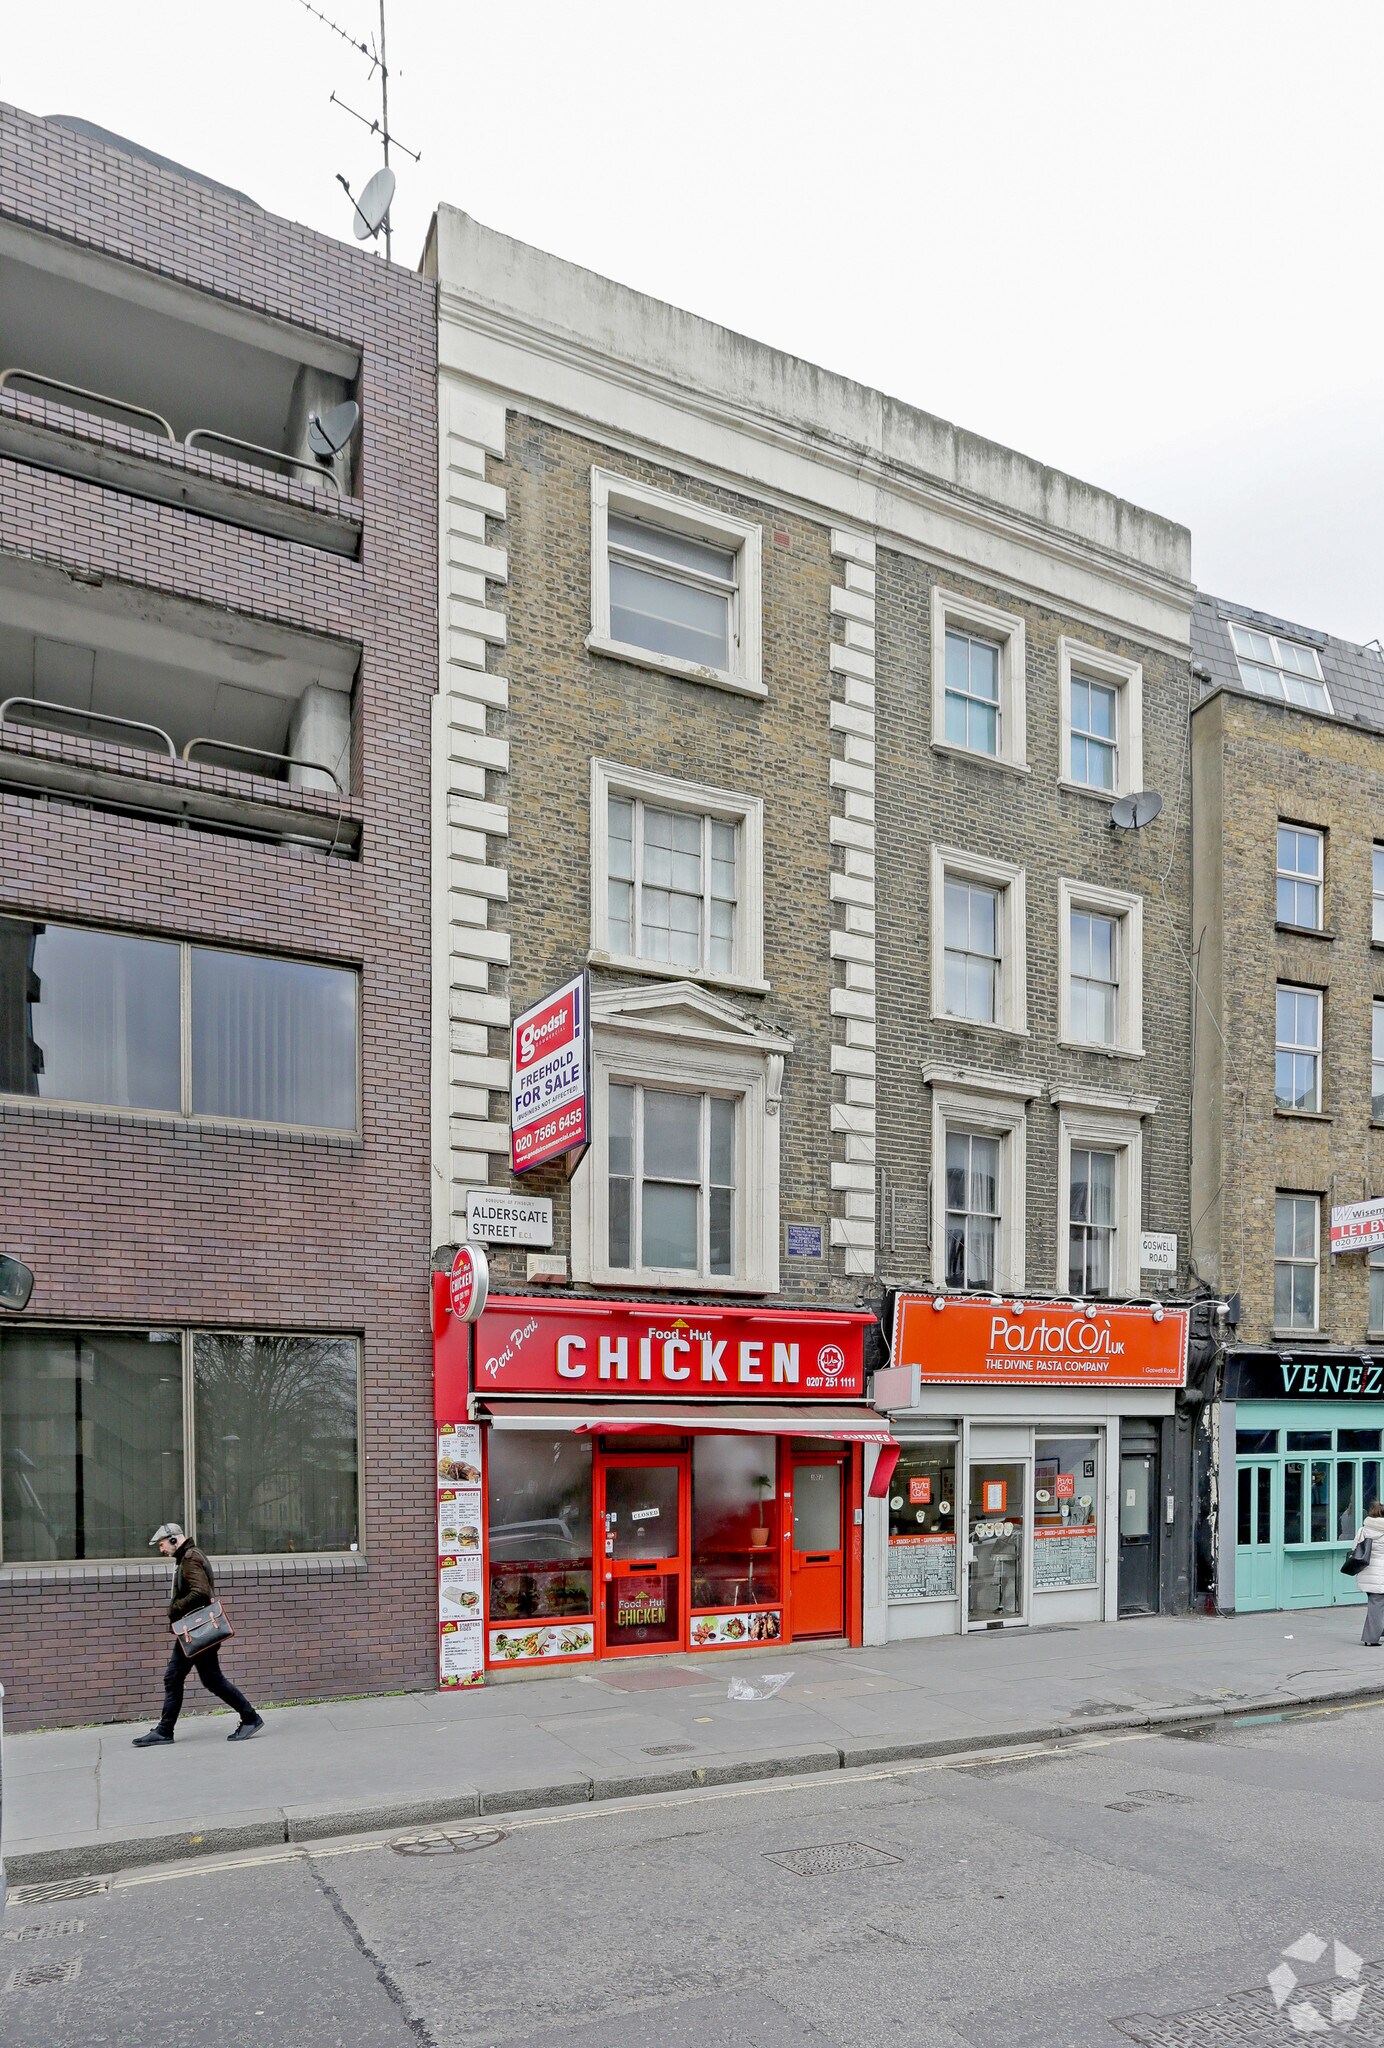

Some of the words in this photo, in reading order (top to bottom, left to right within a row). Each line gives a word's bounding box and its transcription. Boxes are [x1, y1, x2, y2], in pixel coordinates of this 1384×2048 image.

[521, 1009, 568, 1063] goodsir
[536, 1027, 566, 1047] COMMERCIAL
[521, 1051, 573, 1090] FREEHOLD
[515, 1086, 540, 1112] FOR
[544, 1063, 580, 1096] SALE
[517, 1104, 540, 1122] (BUSINESS
[541, 1099, 551, 1109] NOT
[552, 1085, 578, 1103] AFFECTED)
[515, 1134, 532, 1152] 020
[534, 1121, 557, 1143] 7566
[558, 1108, 582, 1131] 6455
[516, 1127, 582, 1163] www.goodsircommercial.co.uk
[472, 1206, 548, 1223] ALDERSGATE
[473, 1223, 517, 1238] STREET
[1341, 1223, 1368, 1237] LET
[1143, 1241, 1174, 1251] GOSWELL
[1353, 1235, 1373, 1244] 7713
[1149, 1253, 1168, 1263] ROAD
[451, 1271, 472, 1293] CHICKEN
[648, 1328, 680, 1340] Food
[689, 1329, 712, 1341] Hut
[484, 1345, 514, 1379] Peri
[509, 1316, 539, 1350] Peri
[556, 1335, 800, 1383] CHICKEN
[986, 1359, 1003, 1370] THE
[1004, 1359, 1033, 1370] DIVINE
[1037, 1361, 1062, 1371] PASTA
[1064, 1361, 1109, 1372] COMPANY
[806, 1377, 822, 1386] 0207
[825, 1377, 838, 1387] 251
[840, 1378, 855, 1387] 1111
[1280, 1364, 1384, 1393] VENEZ
[842, 1434, 890, 1442] CURRIES
[633, 1510, 659, 1519] CLOSED
[618, 1600, 642, 1609] Food
[649, 1599, 666, 1607] Hut
[618, 1608, 666, 1626] CHICKEN
